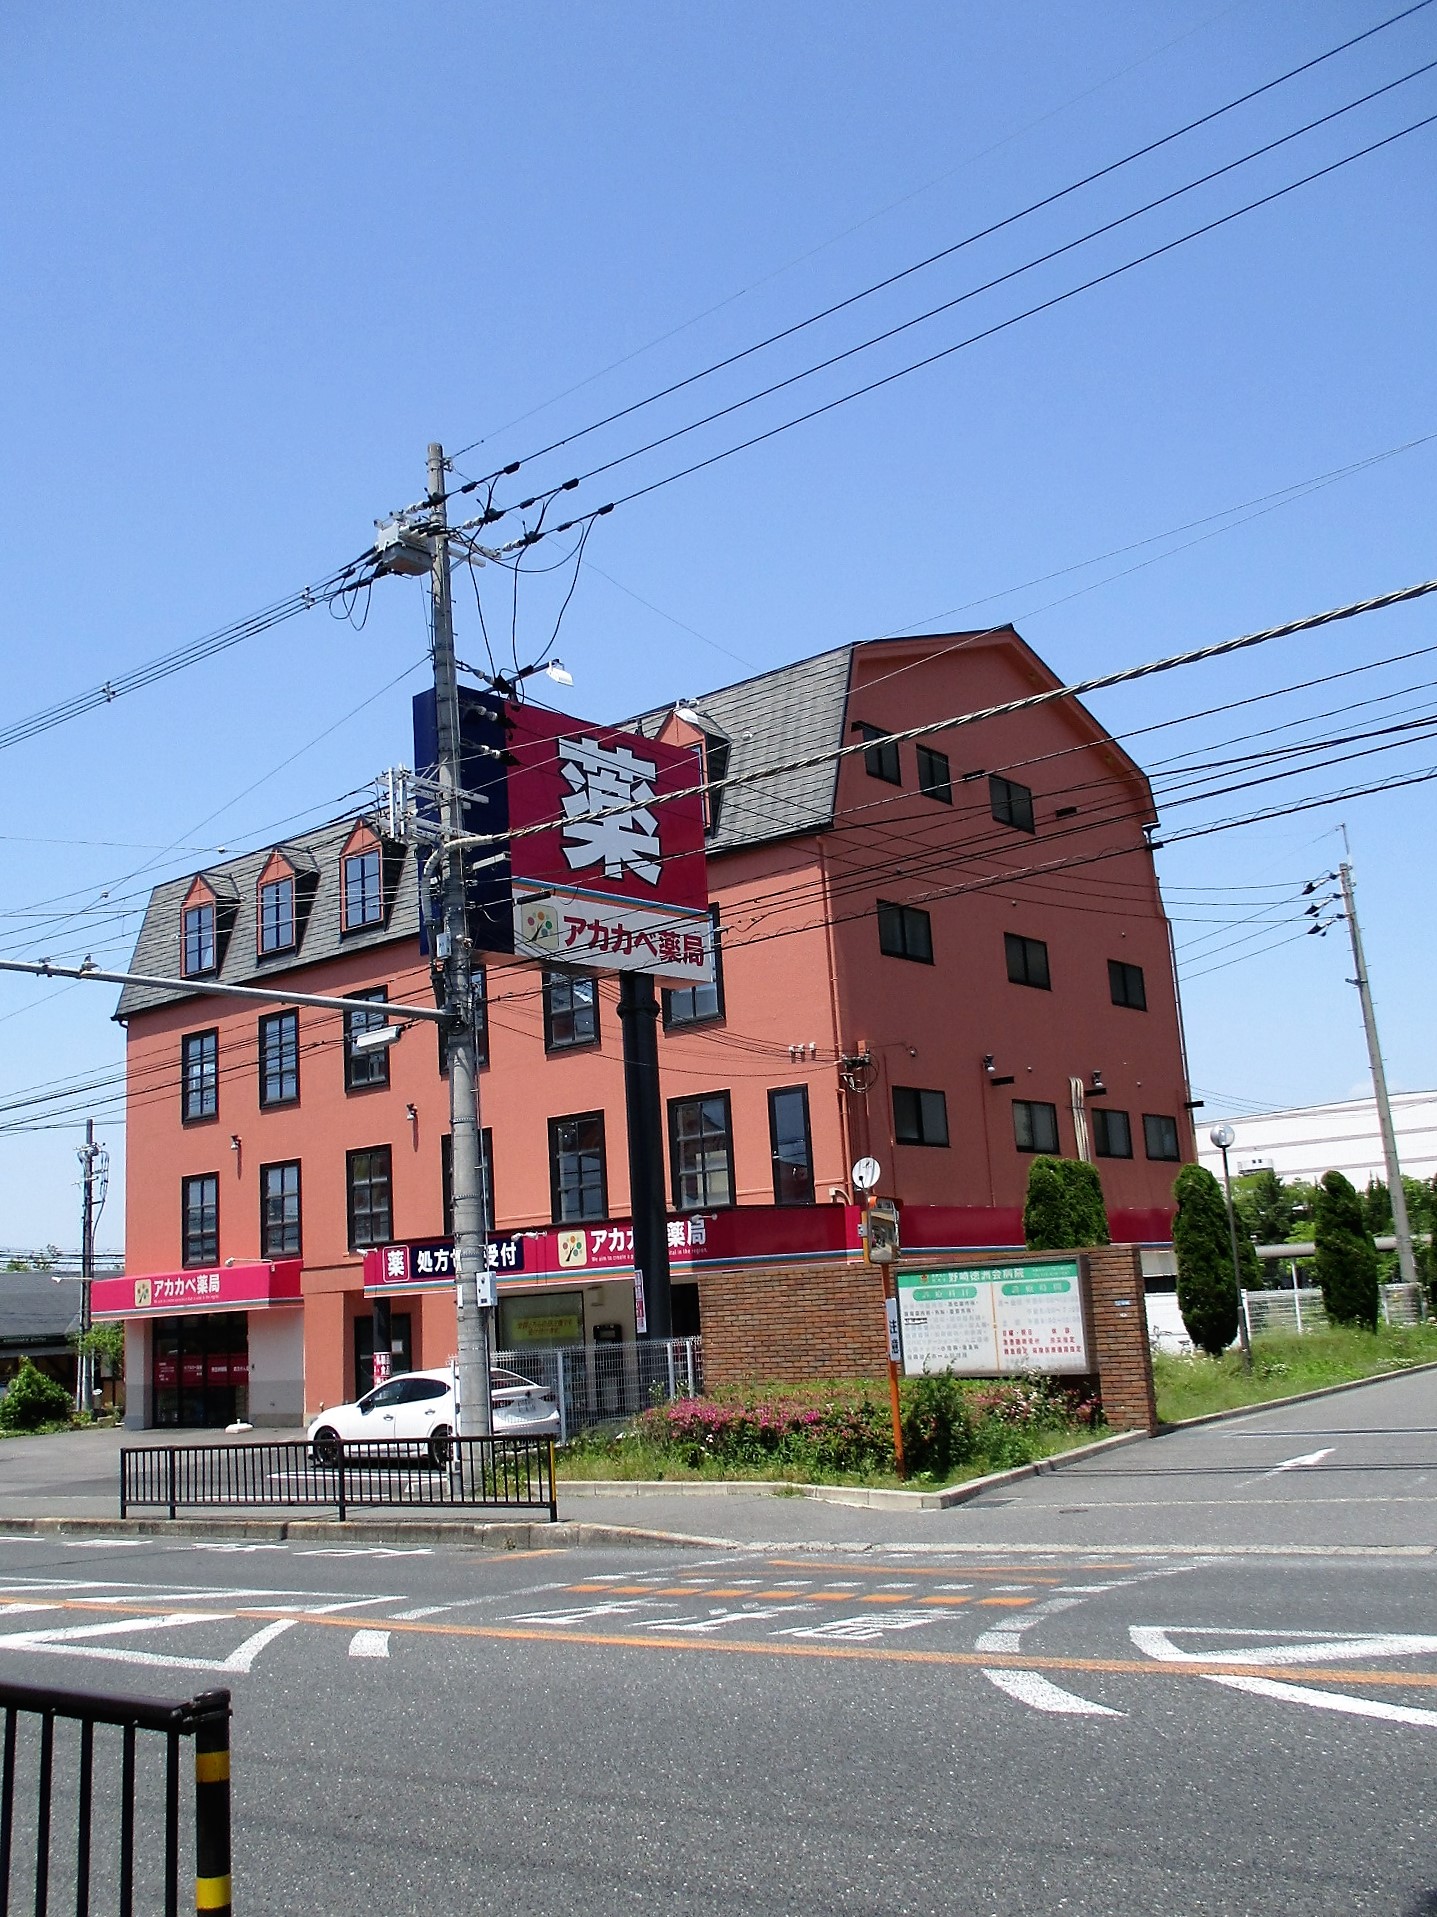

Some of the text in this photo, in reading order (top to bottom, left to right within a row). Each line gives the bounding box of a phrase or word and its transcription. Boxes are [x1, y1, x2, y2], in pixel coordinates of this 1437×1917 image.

[557, 734, 664, 888] 薬
[563, 915, 705, 967] アカカベ薬局
[590, 1220, 707, 1255] アカ薬局
[387, 1249, 405, 1277] 薬
[153, 1273, 220, 1298] アカカベ薬局
[889, 1319, 900, 1355] 注意
